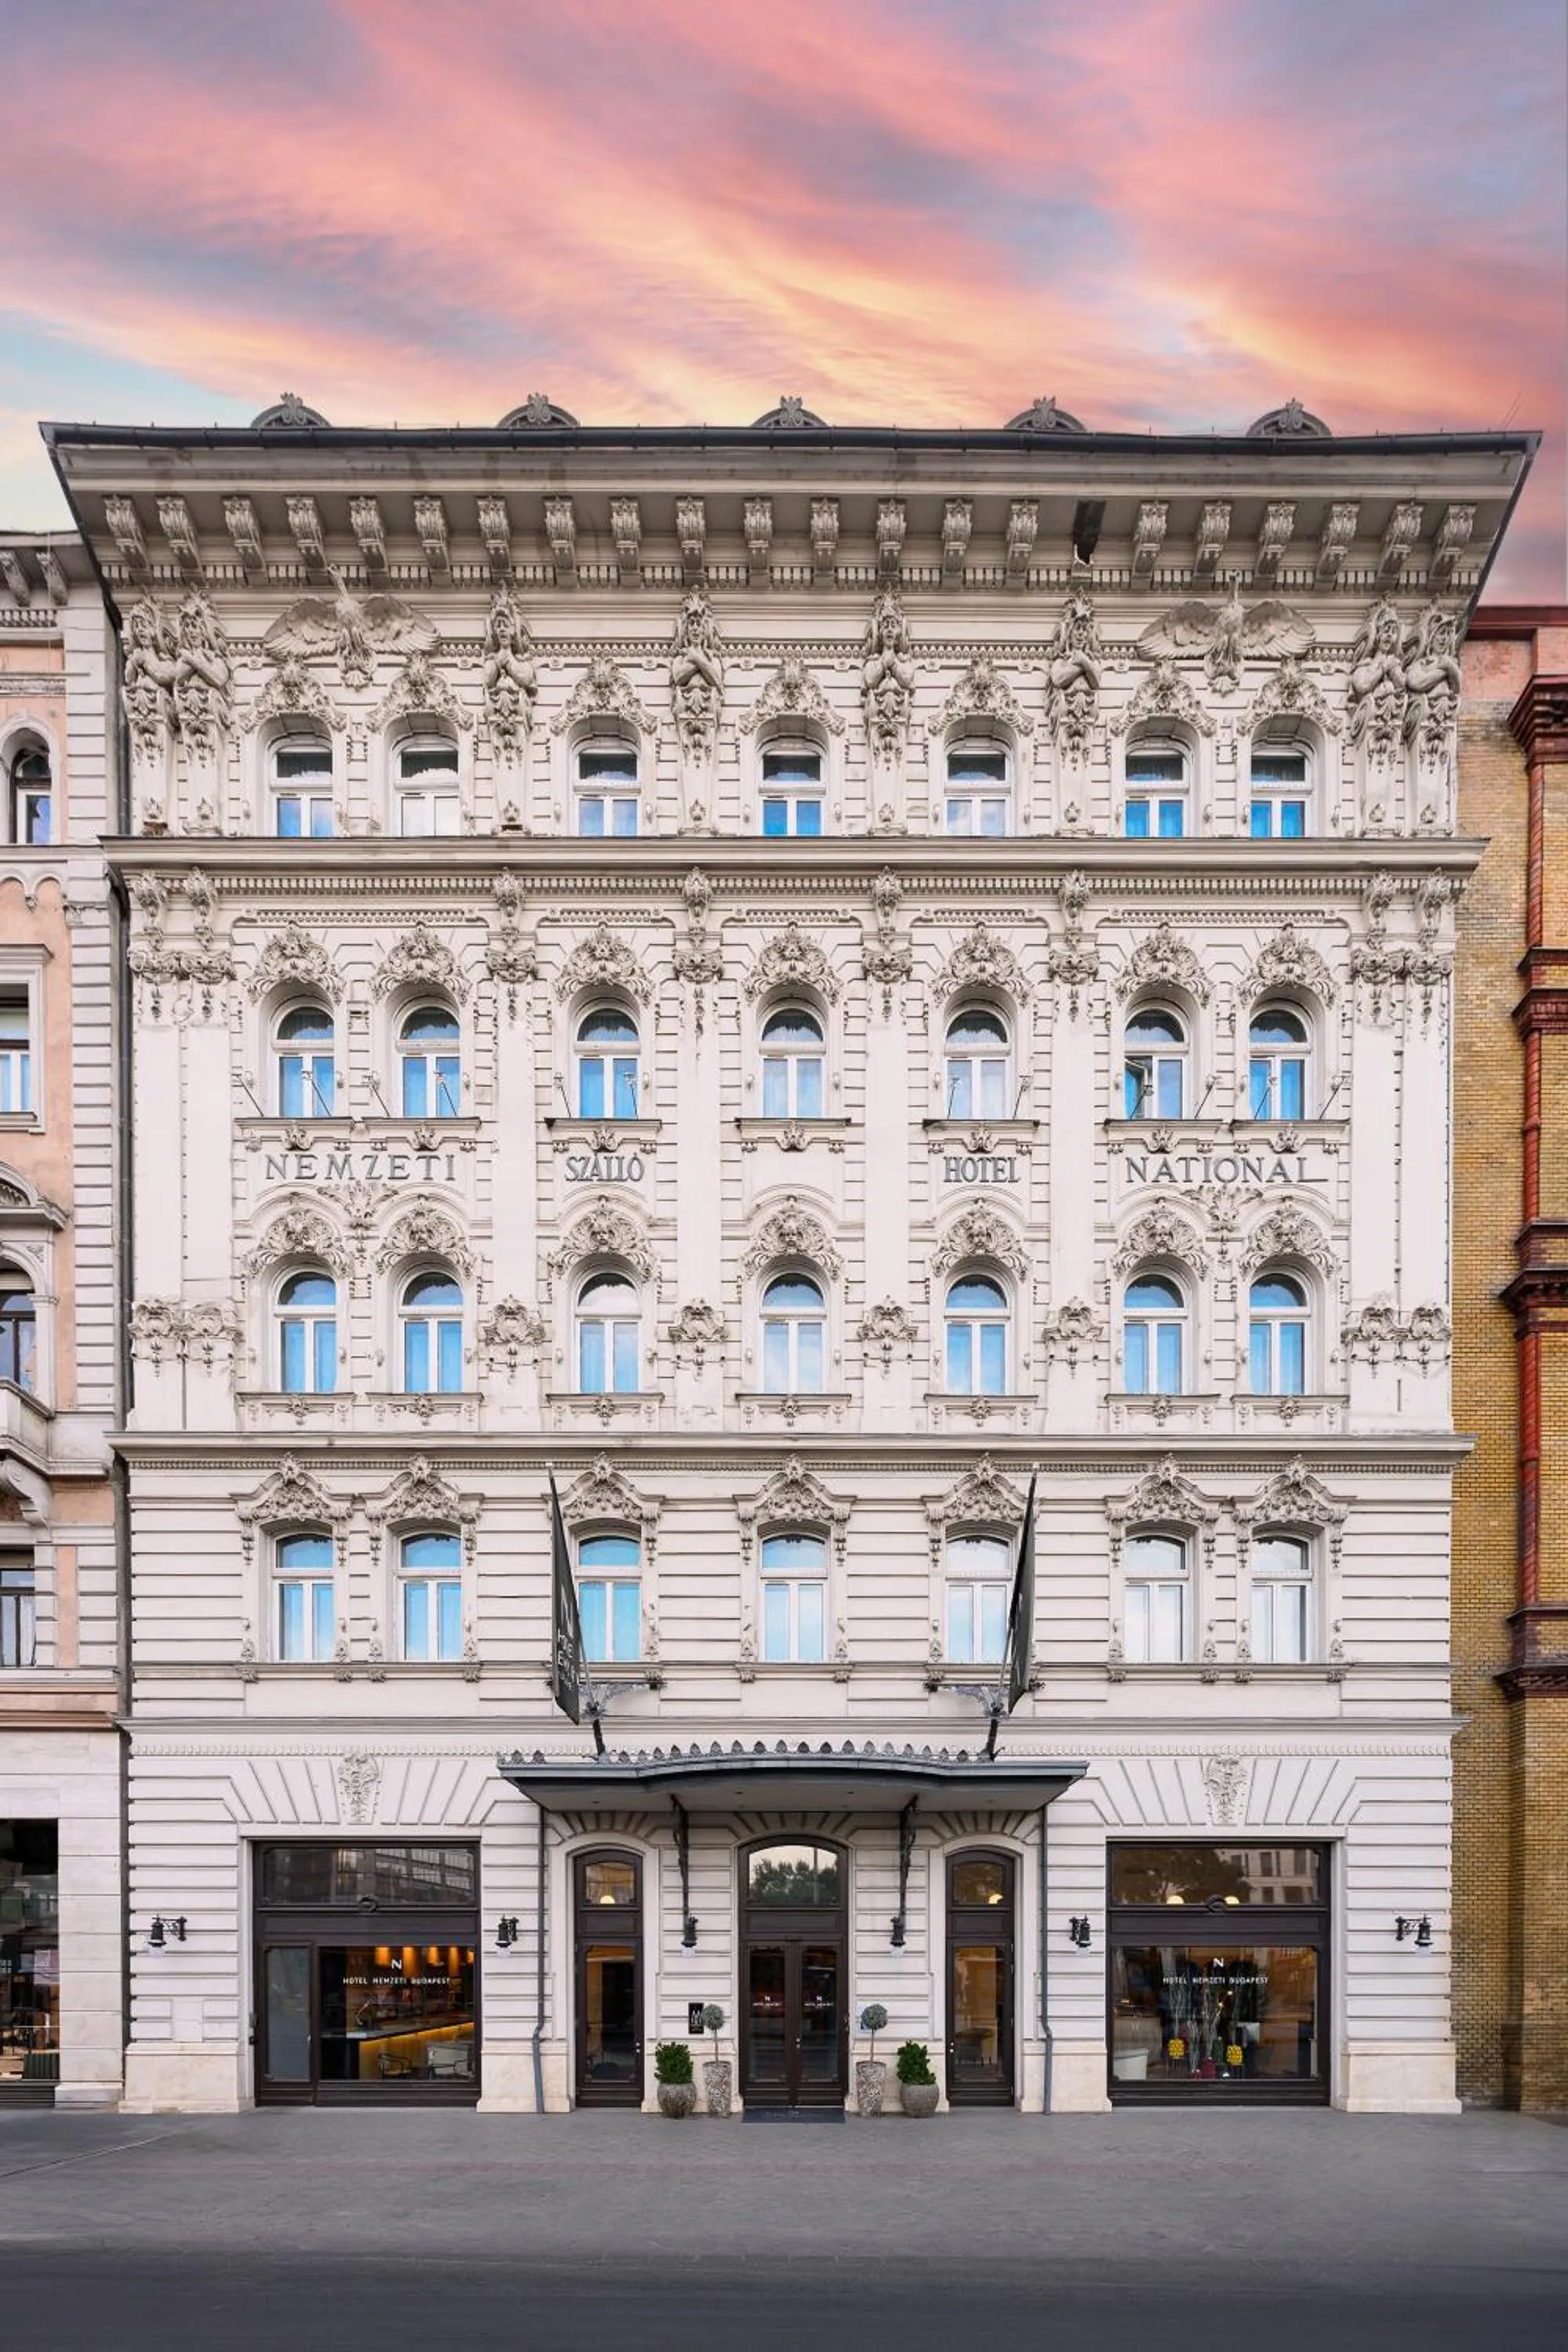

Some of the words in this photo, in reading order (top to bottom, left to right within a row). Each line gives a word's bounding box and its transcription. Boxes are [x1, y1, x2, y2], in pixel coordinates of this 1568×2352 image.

[265, 1153, 456, 1181] NEMZETI
[943, 1156, 1021, 1183] HOTEL
[1125, 1156, 1329, 1183] NATIONAL
[391, 1958, 402, 1969] N
[1213, 1958, 1224, 1968] N
